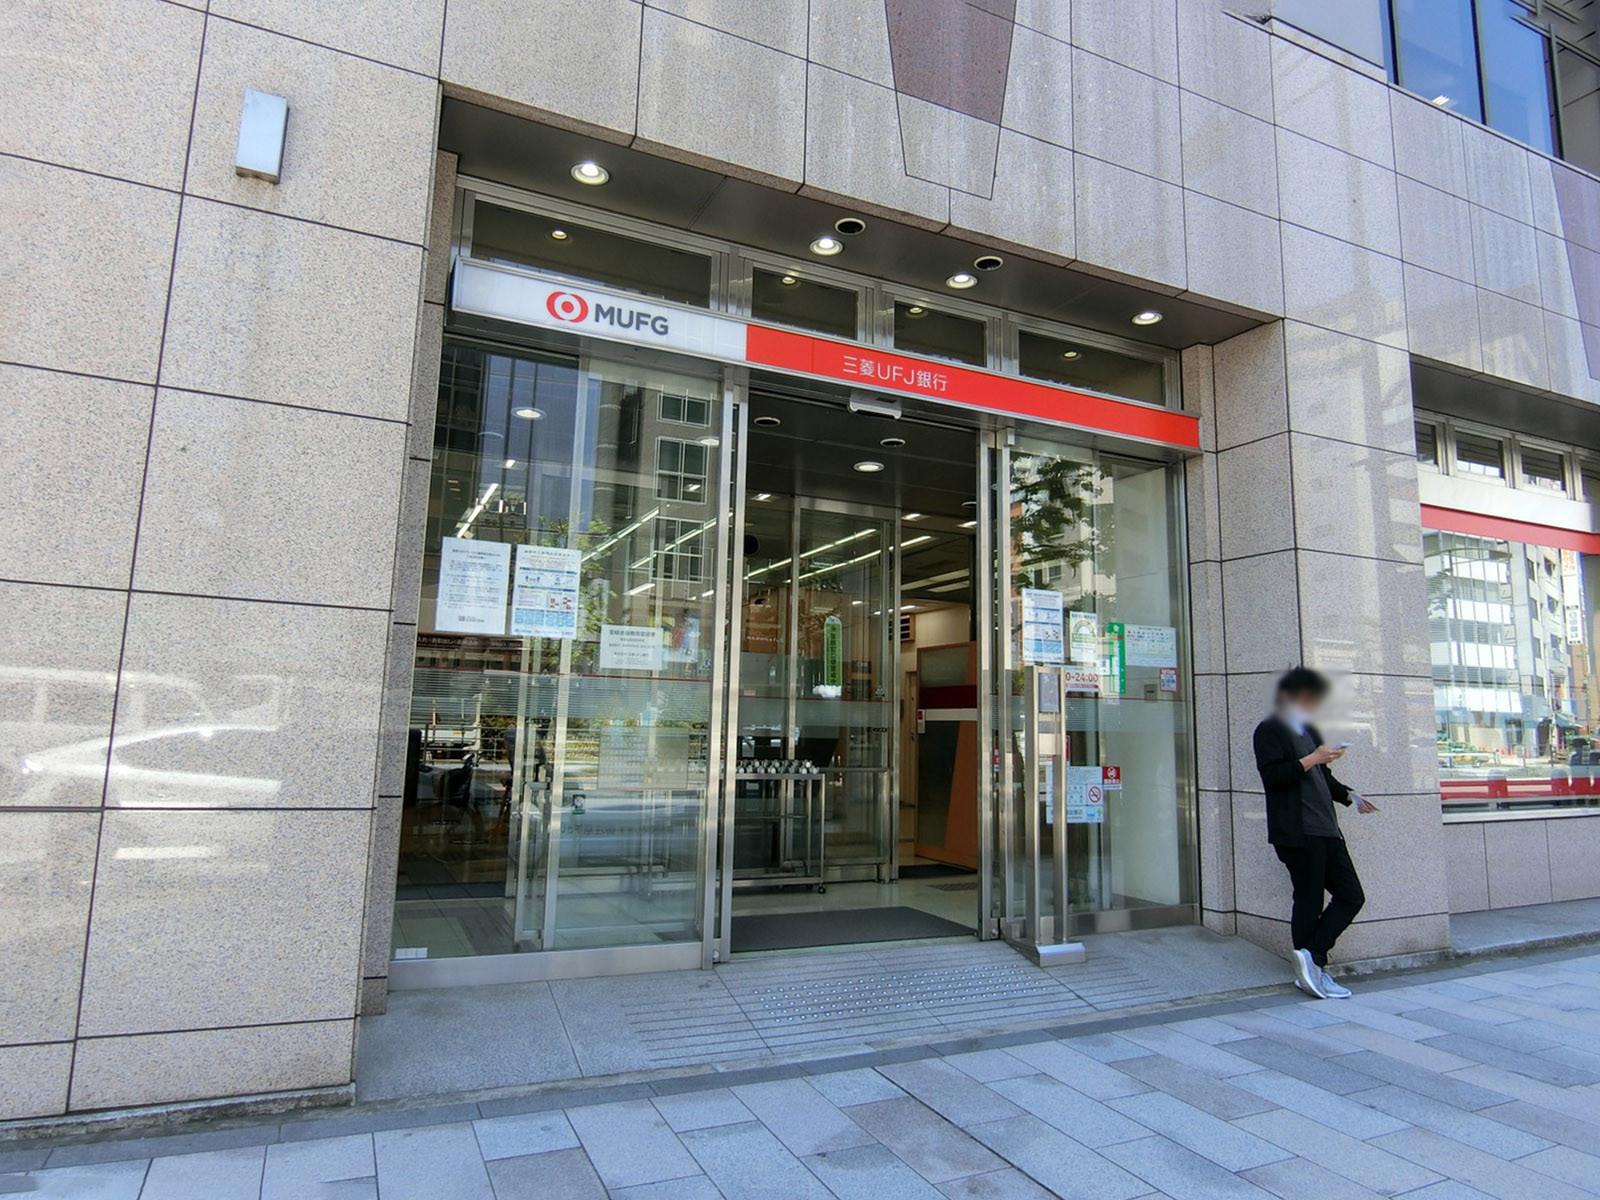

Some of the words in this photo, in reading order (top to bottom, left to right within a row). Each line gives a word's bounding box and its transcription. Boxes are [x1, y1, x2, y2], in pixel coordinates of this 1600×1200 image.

[595, 303, 669, 336] MUFG
[843, 355, 947, 391] 三菱UFJ銀行
